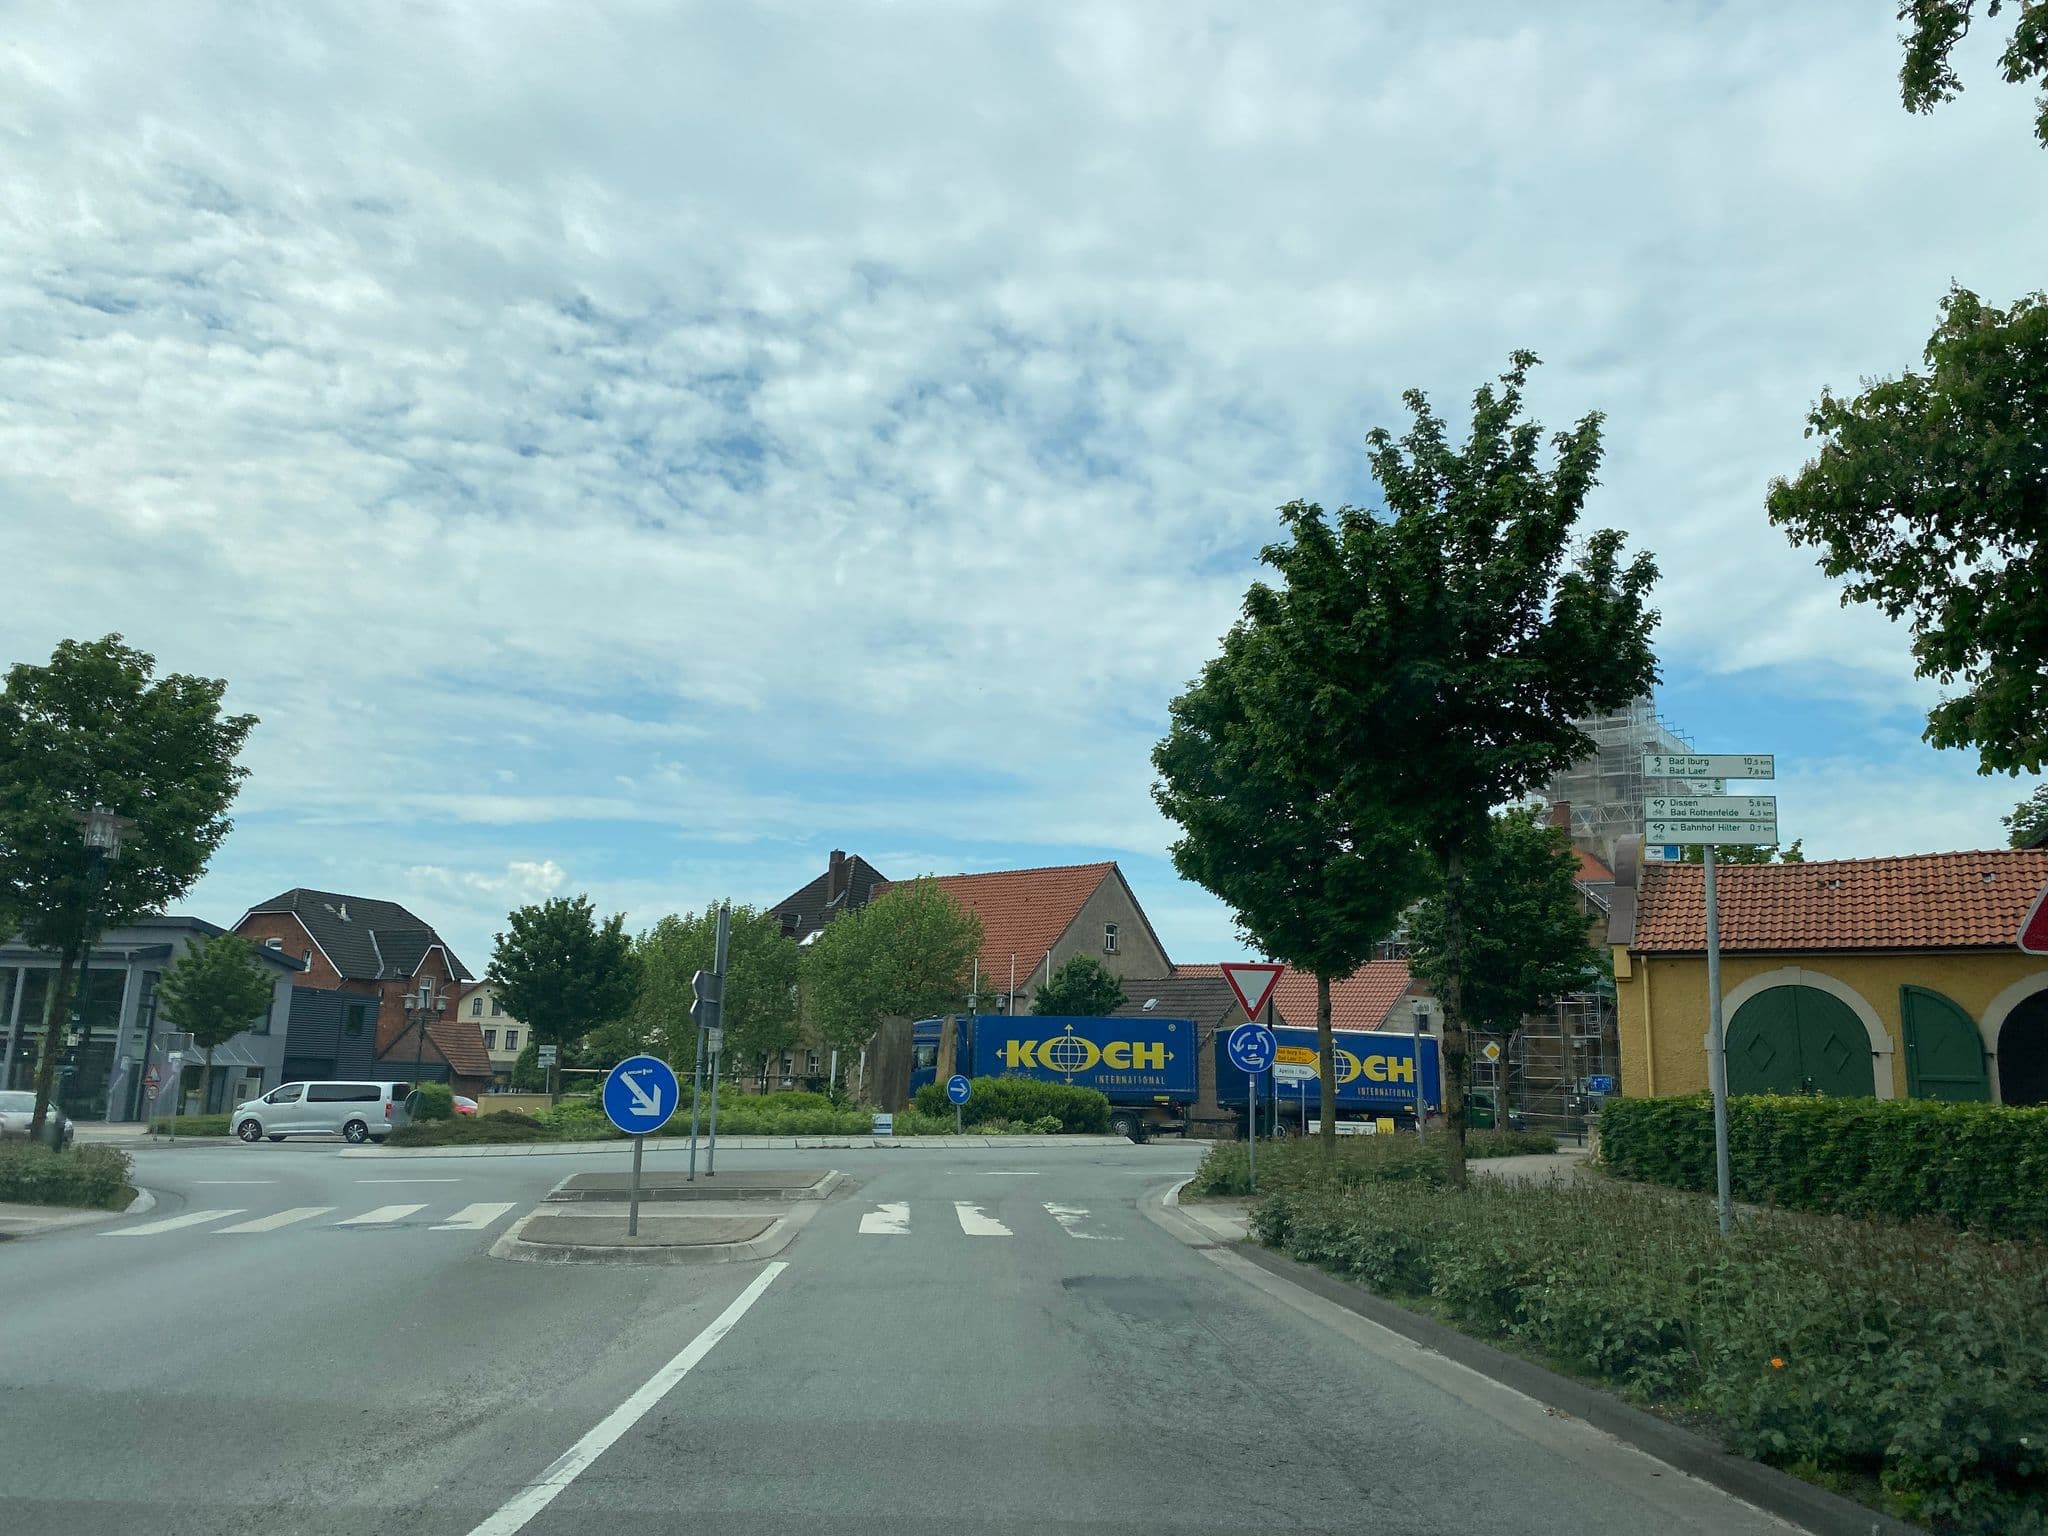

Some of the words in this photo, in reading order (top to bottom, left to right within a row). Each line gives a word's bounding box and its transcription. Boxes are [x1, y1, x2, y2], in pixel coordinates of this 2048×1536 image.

[1669, 757, 1685, 765] Bad
[1687, 757, 1710, 767] Iburg
[1669, 767, 1685, 775] Bad
[1688, 767, 1707, 775] Laer
[1670, 799, 1698, 807] Dissen
[1670, 809, 1687, 817] Bad
[1689, 808, 1739, 817] Rothenfelde
[1680, 823, 1715, 832] Bahnhof
[1718, 823, 1741, 832] Hilter
[1006, 1036, 1165, 1073] KOCH
[1095, 1074, 1165, 1085] INTERNATIONAL
[1357, 1087, 1415, 1098] INTERNATIONAL
